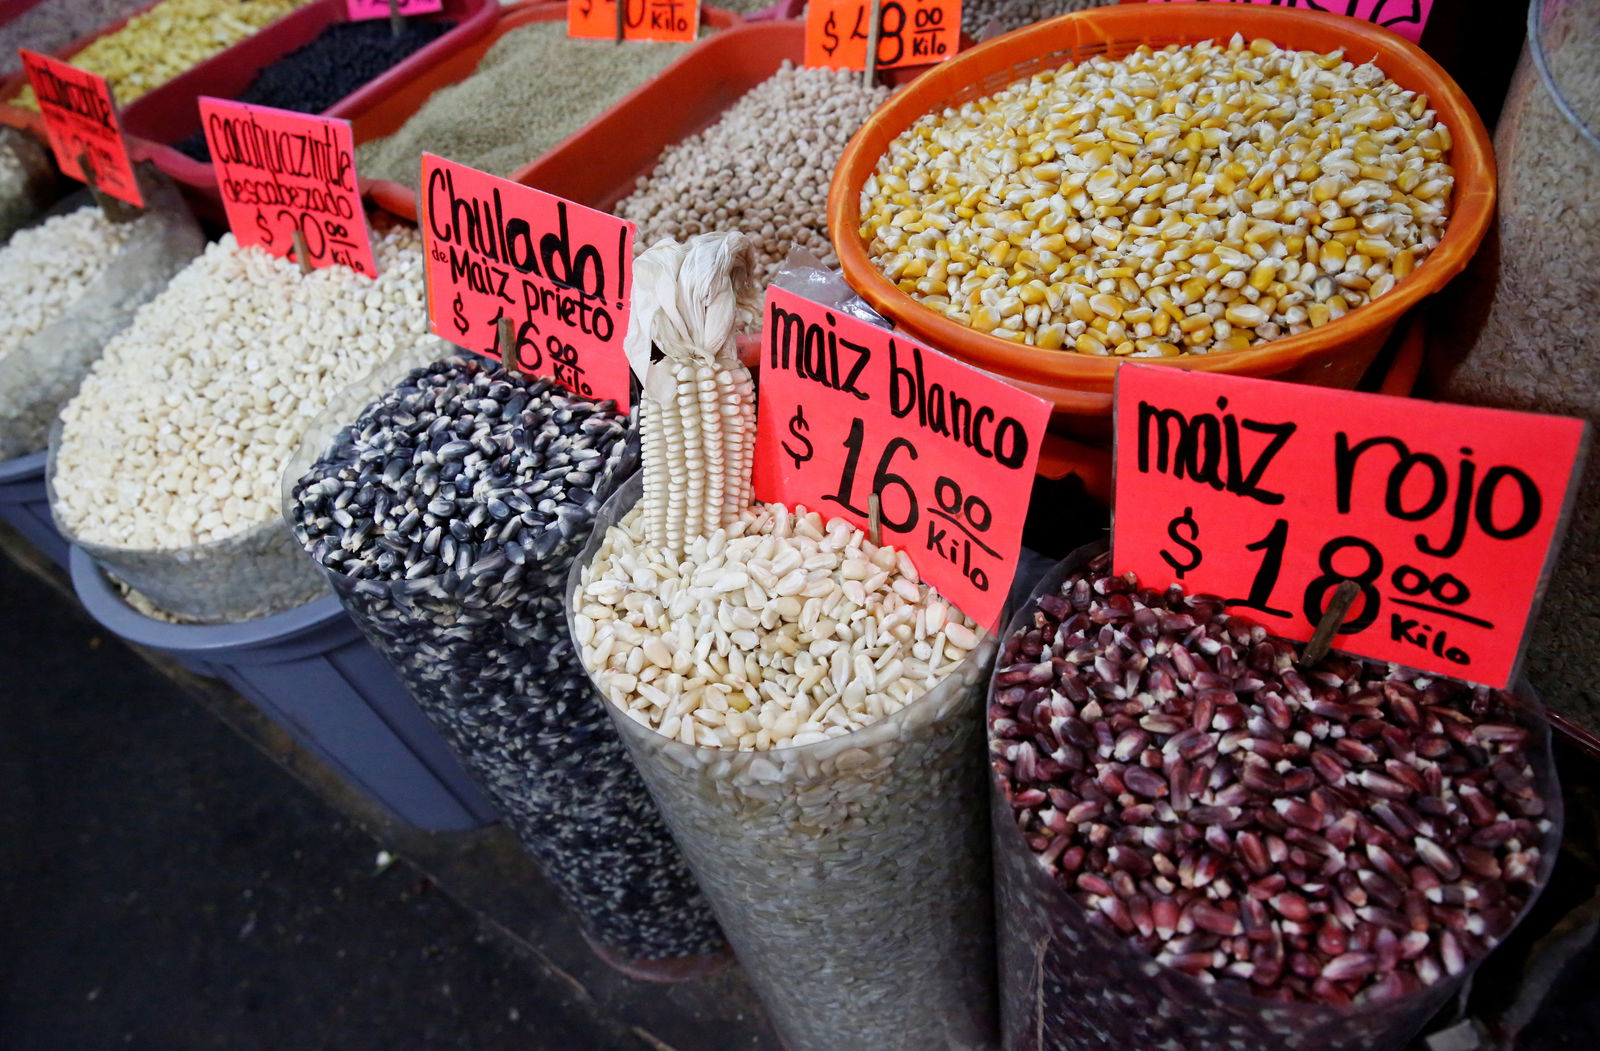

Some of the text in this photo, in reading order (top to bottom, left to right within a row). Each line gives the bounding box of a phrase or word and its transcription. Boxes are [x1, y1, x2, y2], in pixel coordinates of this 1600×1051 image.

[651, 4, 688, 32] Kilo
[822, 10, 839, 57] $
[913, 33, 947, 57] Kilo
[256, 208, 274, 247] $
[331, 248, 364, 272] Kilo
[432, 240, 448, 263] de
[449, 245, 516, 304] Maiz
[453, 292, 470, 335] $
[553, 362, 593, 396] Kilo
[771, 301, 1029, 470] maiz blanco
[781, 404, 814, 470] $
[1138, 396, 1542, 558] maiz rojo
[927, 521, 989, 592] Kilo
[1160, 507, 1202, 579] $
[1390, 613, 1471, 666] Kilo
